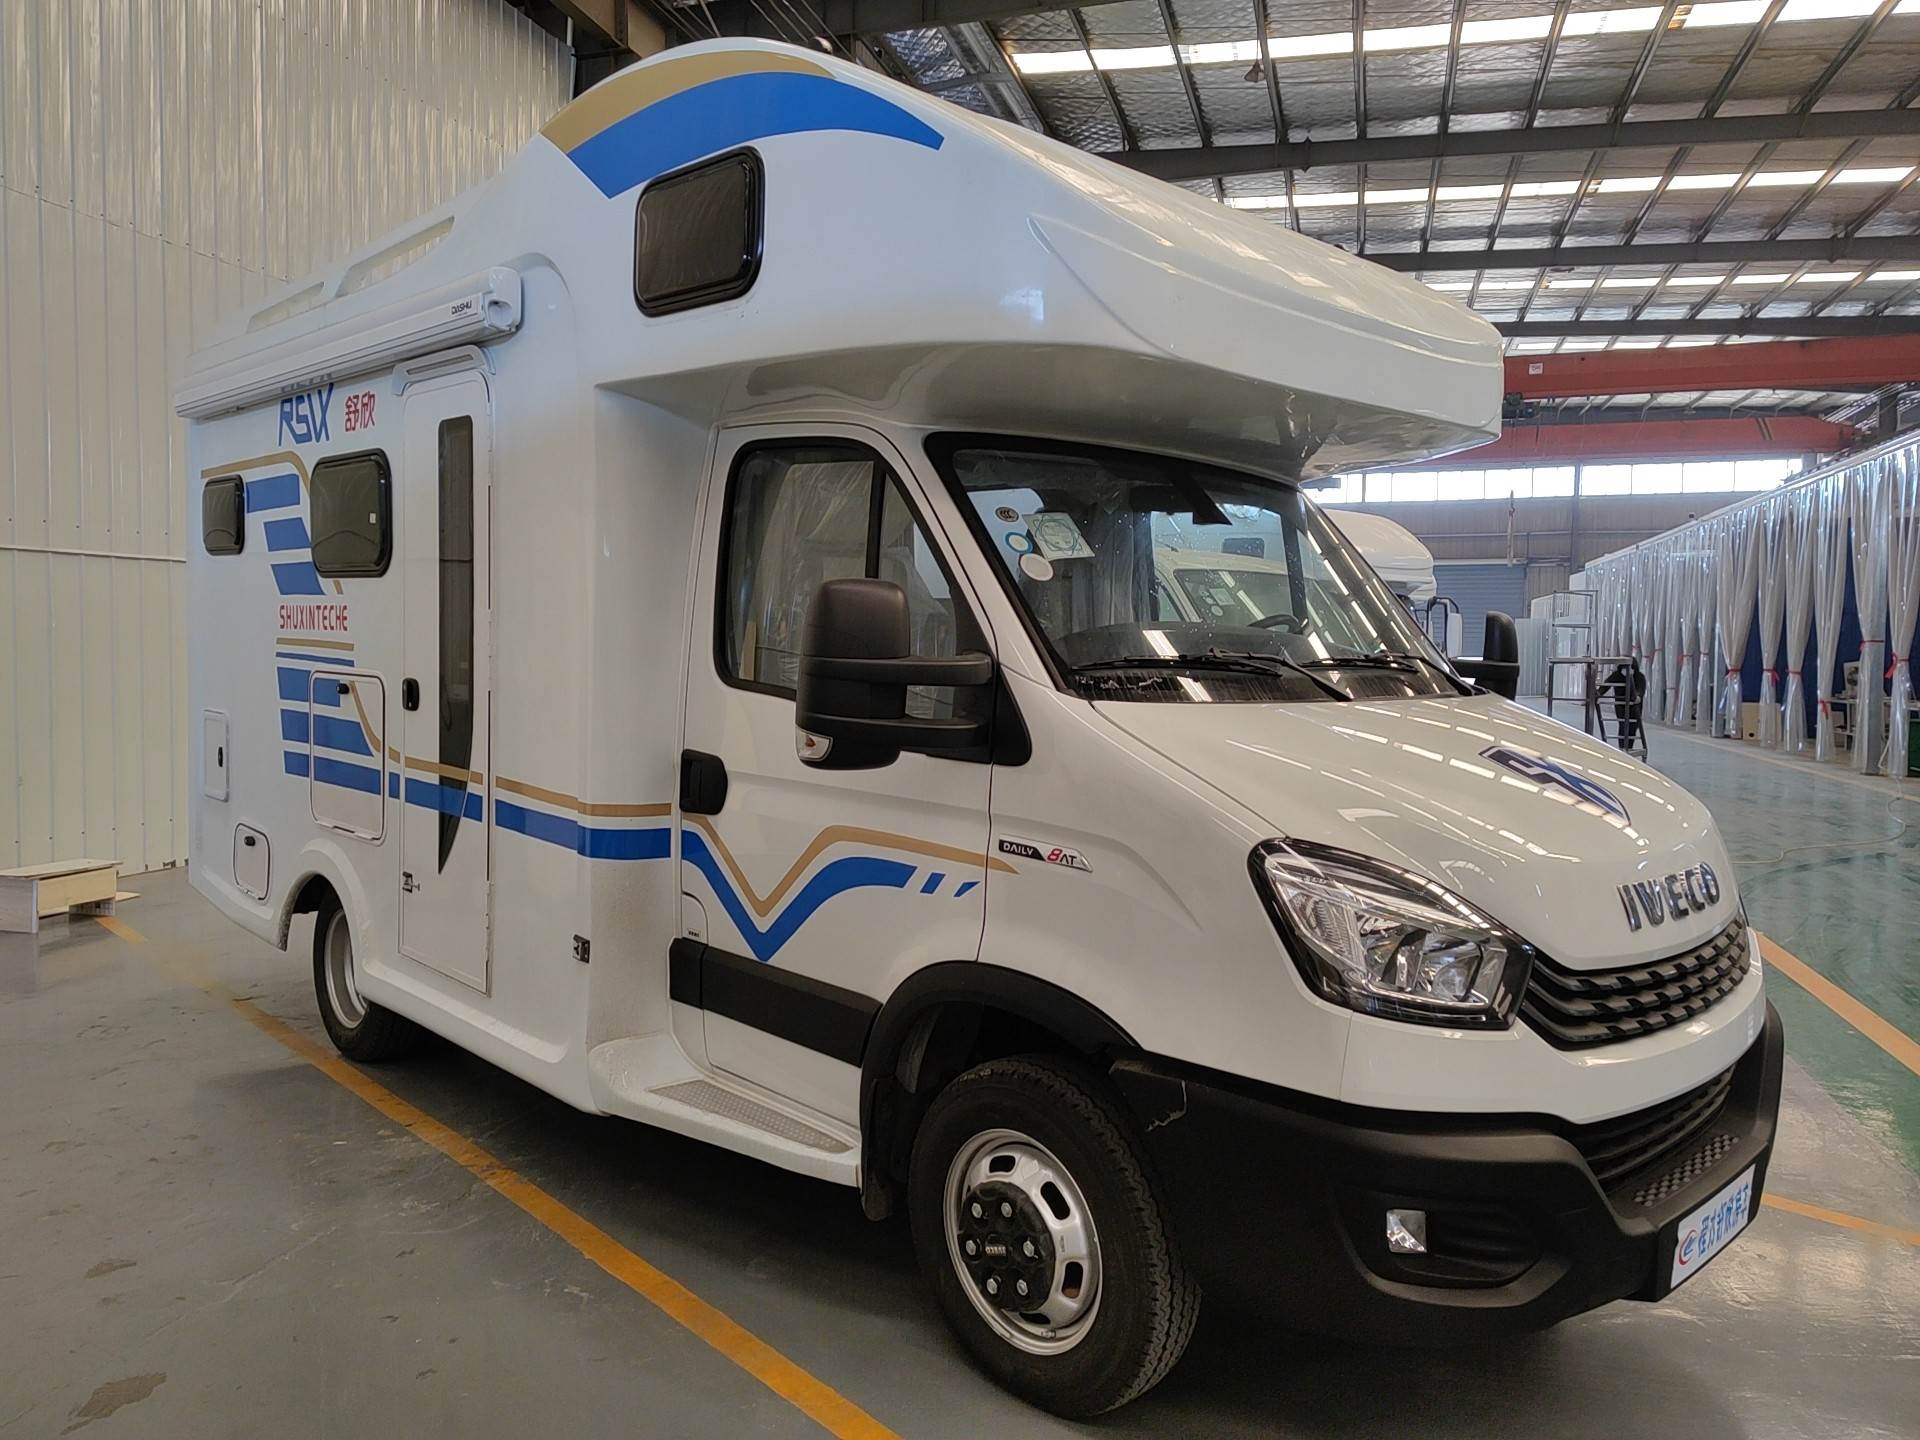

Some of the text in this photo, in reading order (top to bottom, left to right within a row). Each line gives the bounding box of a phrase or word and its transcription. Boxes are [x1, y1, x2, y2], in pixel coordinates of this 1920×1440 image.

[344, 391, 376, 432] 舒欣
[279, 604, 348, 631] SHUXINTECHE
[1003, 842, 1077, 865] DAILY 8AT
[1617, 861, 1720, 932] IVECO
